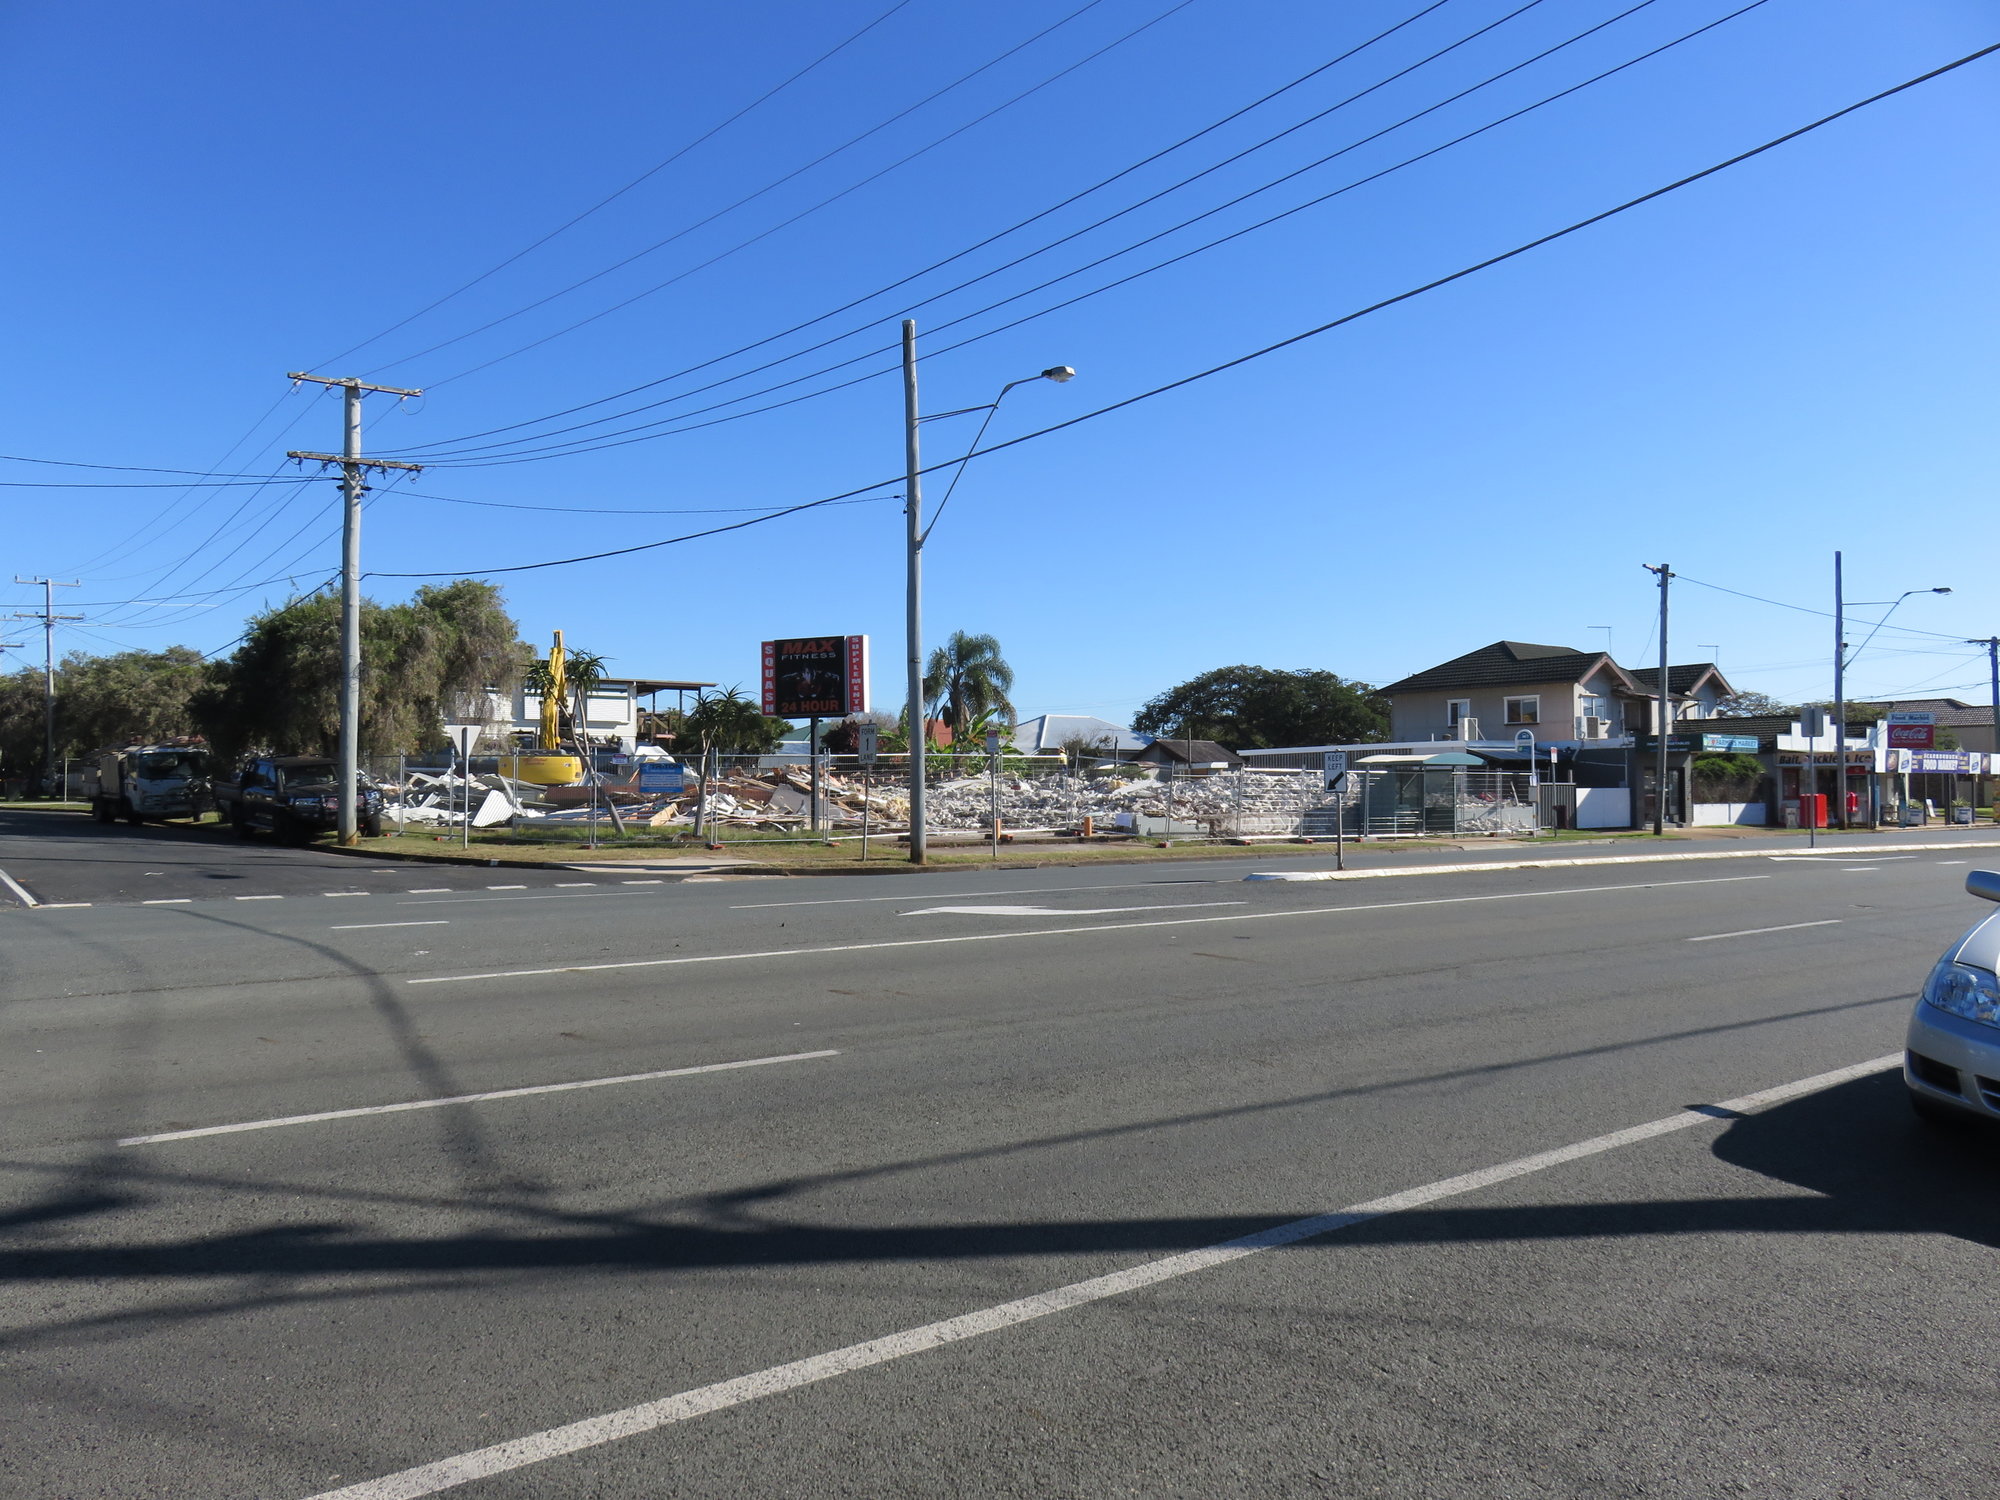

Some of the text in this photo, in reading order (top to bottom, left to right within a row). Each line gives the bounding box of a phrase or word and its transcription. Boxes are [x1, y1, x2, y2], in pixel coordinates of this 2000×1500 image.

[782, 640, 836, 654] MAX
[781, 652, 836, 660] FITNESS
[764, 645, 774, 713] SQUASH
[850, 637, 861, 711] SUPPLEMENTS
[781, 700, 839, 712] 24 HOUR
[1892, 727, 1928, 739] Coca-Cola
[866, 737, 869, 750] 1
[861, 753, 874, 761] LANE
